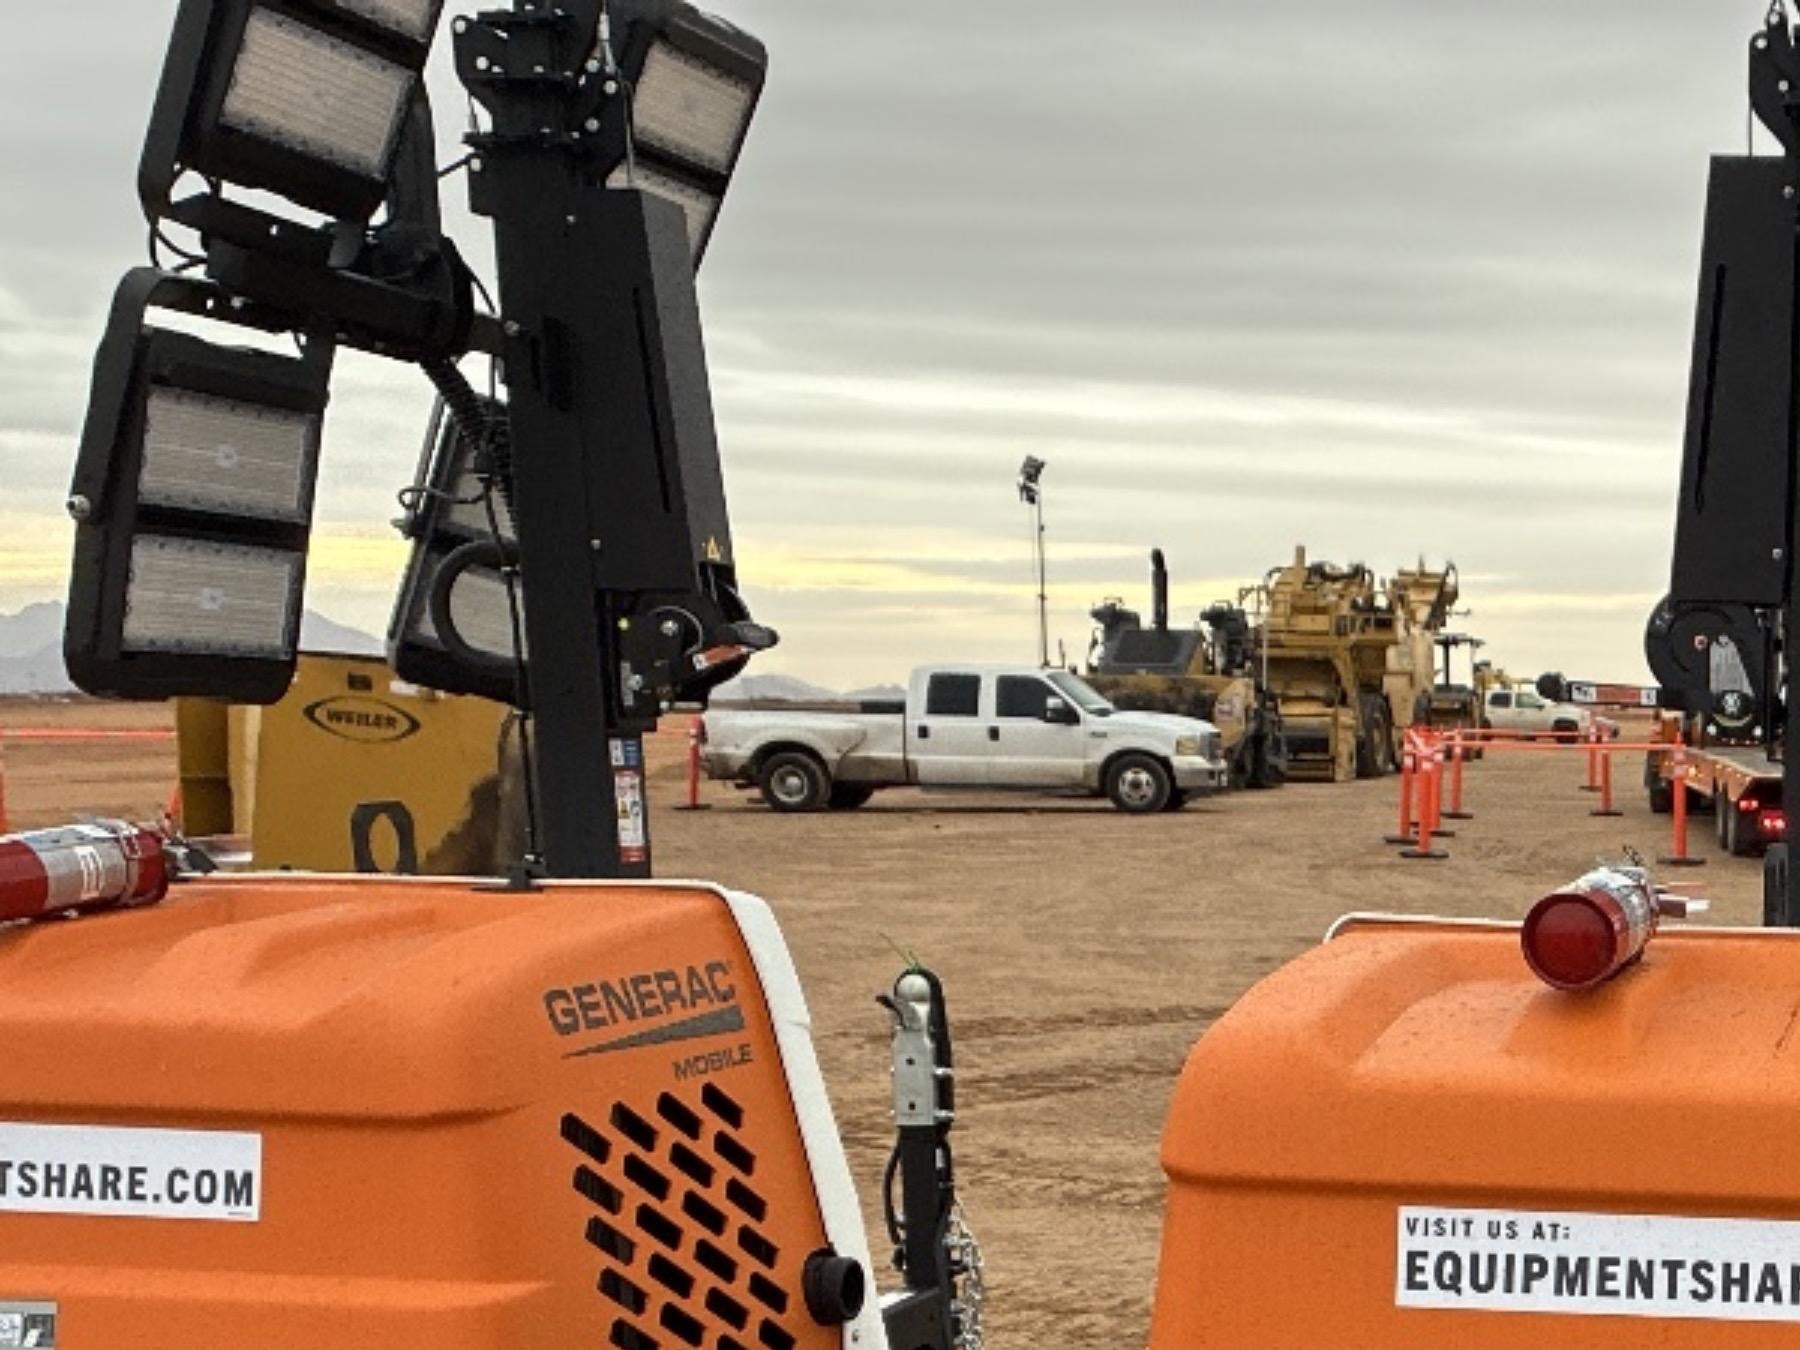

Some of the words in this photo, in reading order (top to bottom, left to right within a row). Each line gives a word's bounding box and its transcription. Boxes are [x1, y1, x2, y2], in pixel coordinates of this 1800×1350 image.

[543, 960, 736, 1036] GENERAC
[673, 1043, 753, 1080] MOBILE
[1405, 1216, 1473, 1239] VISIT
[1487, 1218, 1519, 1240] US
[1532, 1220, 1571, 1242] AT:
